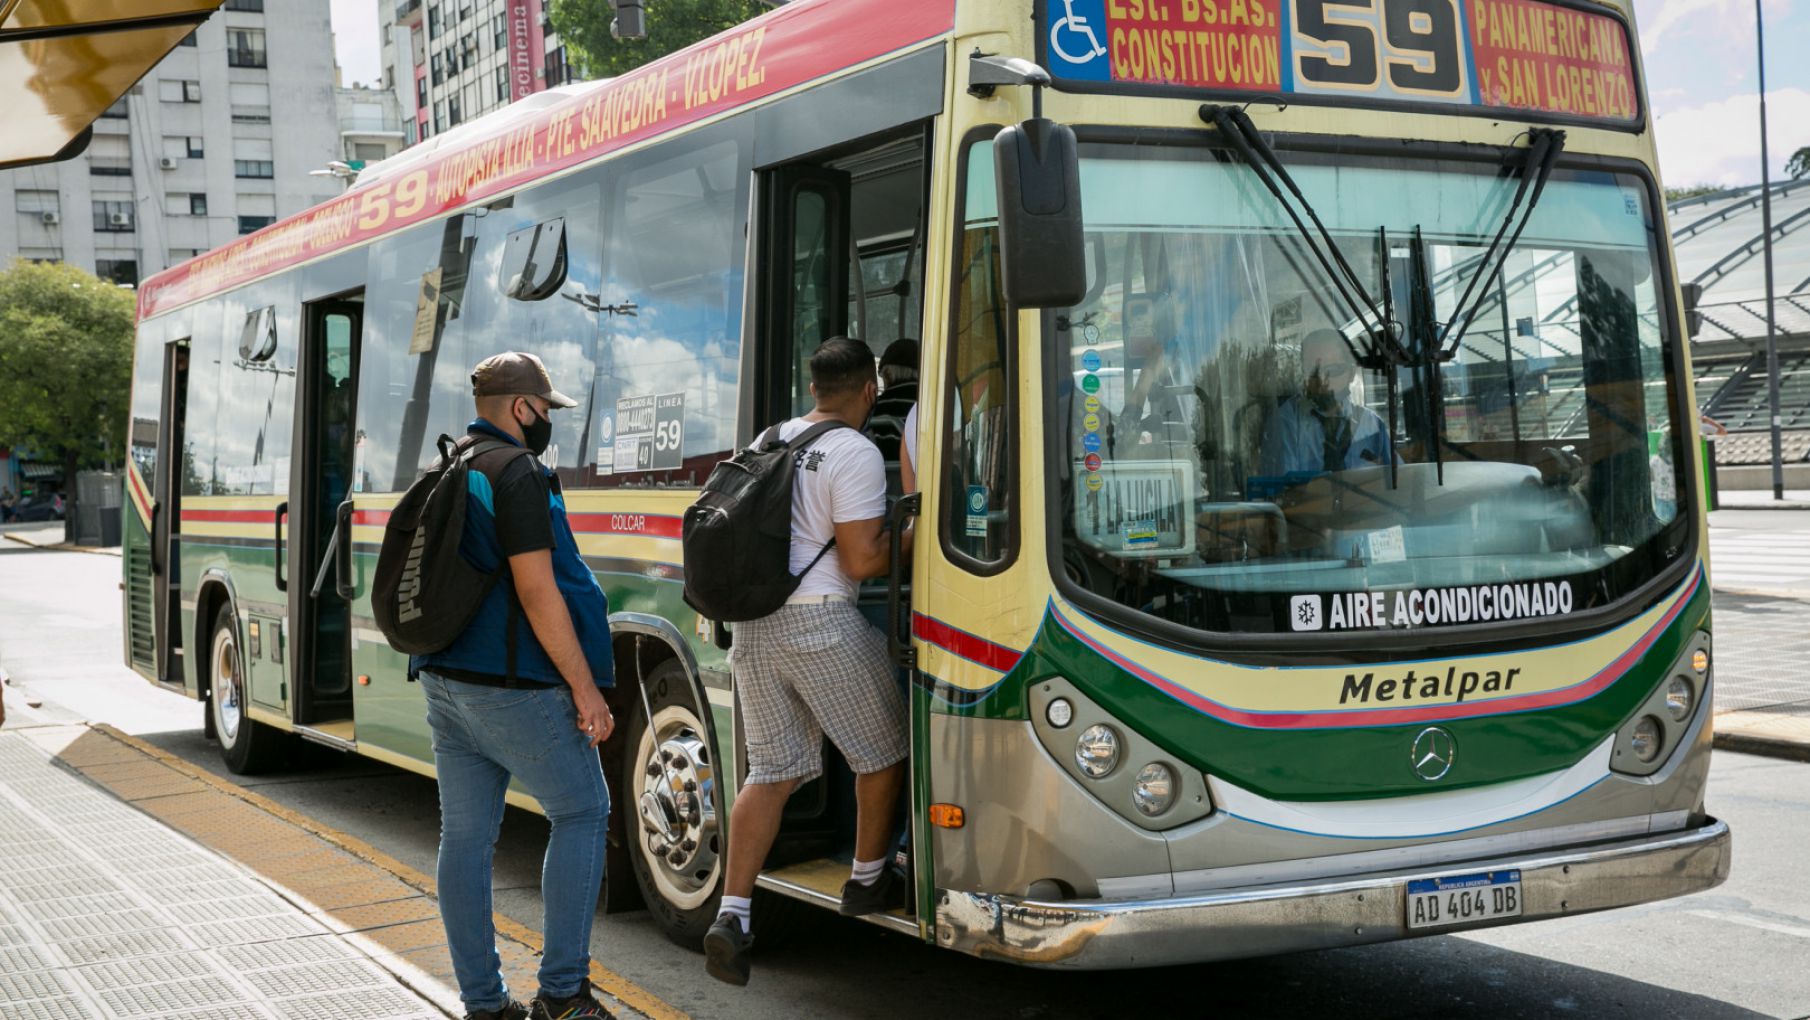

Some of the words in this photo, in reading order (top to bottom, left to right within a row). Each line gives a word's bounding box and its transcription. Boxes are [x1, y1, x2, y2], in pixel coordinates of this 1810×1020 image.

[1113, 27, 1281, 85] CONSTITUCION
[1294, 0, 1464, 97] 59
[1474, 0, 1625, 66] PANAMERICANA
[1498, 55, 1539, 106] SAN
[1544, 62, 1631, 118] LORENZO
[358, 169, 429, 230] 59
[545, 110, 574, 162] PTE.
[579, 68, 670, 149] SAAVEDRA
[658, 397, 682, 409] LINEA
[655, 419, 681, 451] 59
[611, 514, 645, 531] COLCAR
[398, 526, 425, 624] PUMA
[1329, 592, 1386, 629] AIRE
[1393, 580, 1573, 627] ACONDICIONADO
[1339, 666, 1521, 703] Metalpar
[1414, 895, 1440, 924] AD
[1447, 890, 1486, 918] 404
[1492, 886, 1517, 914] DB
